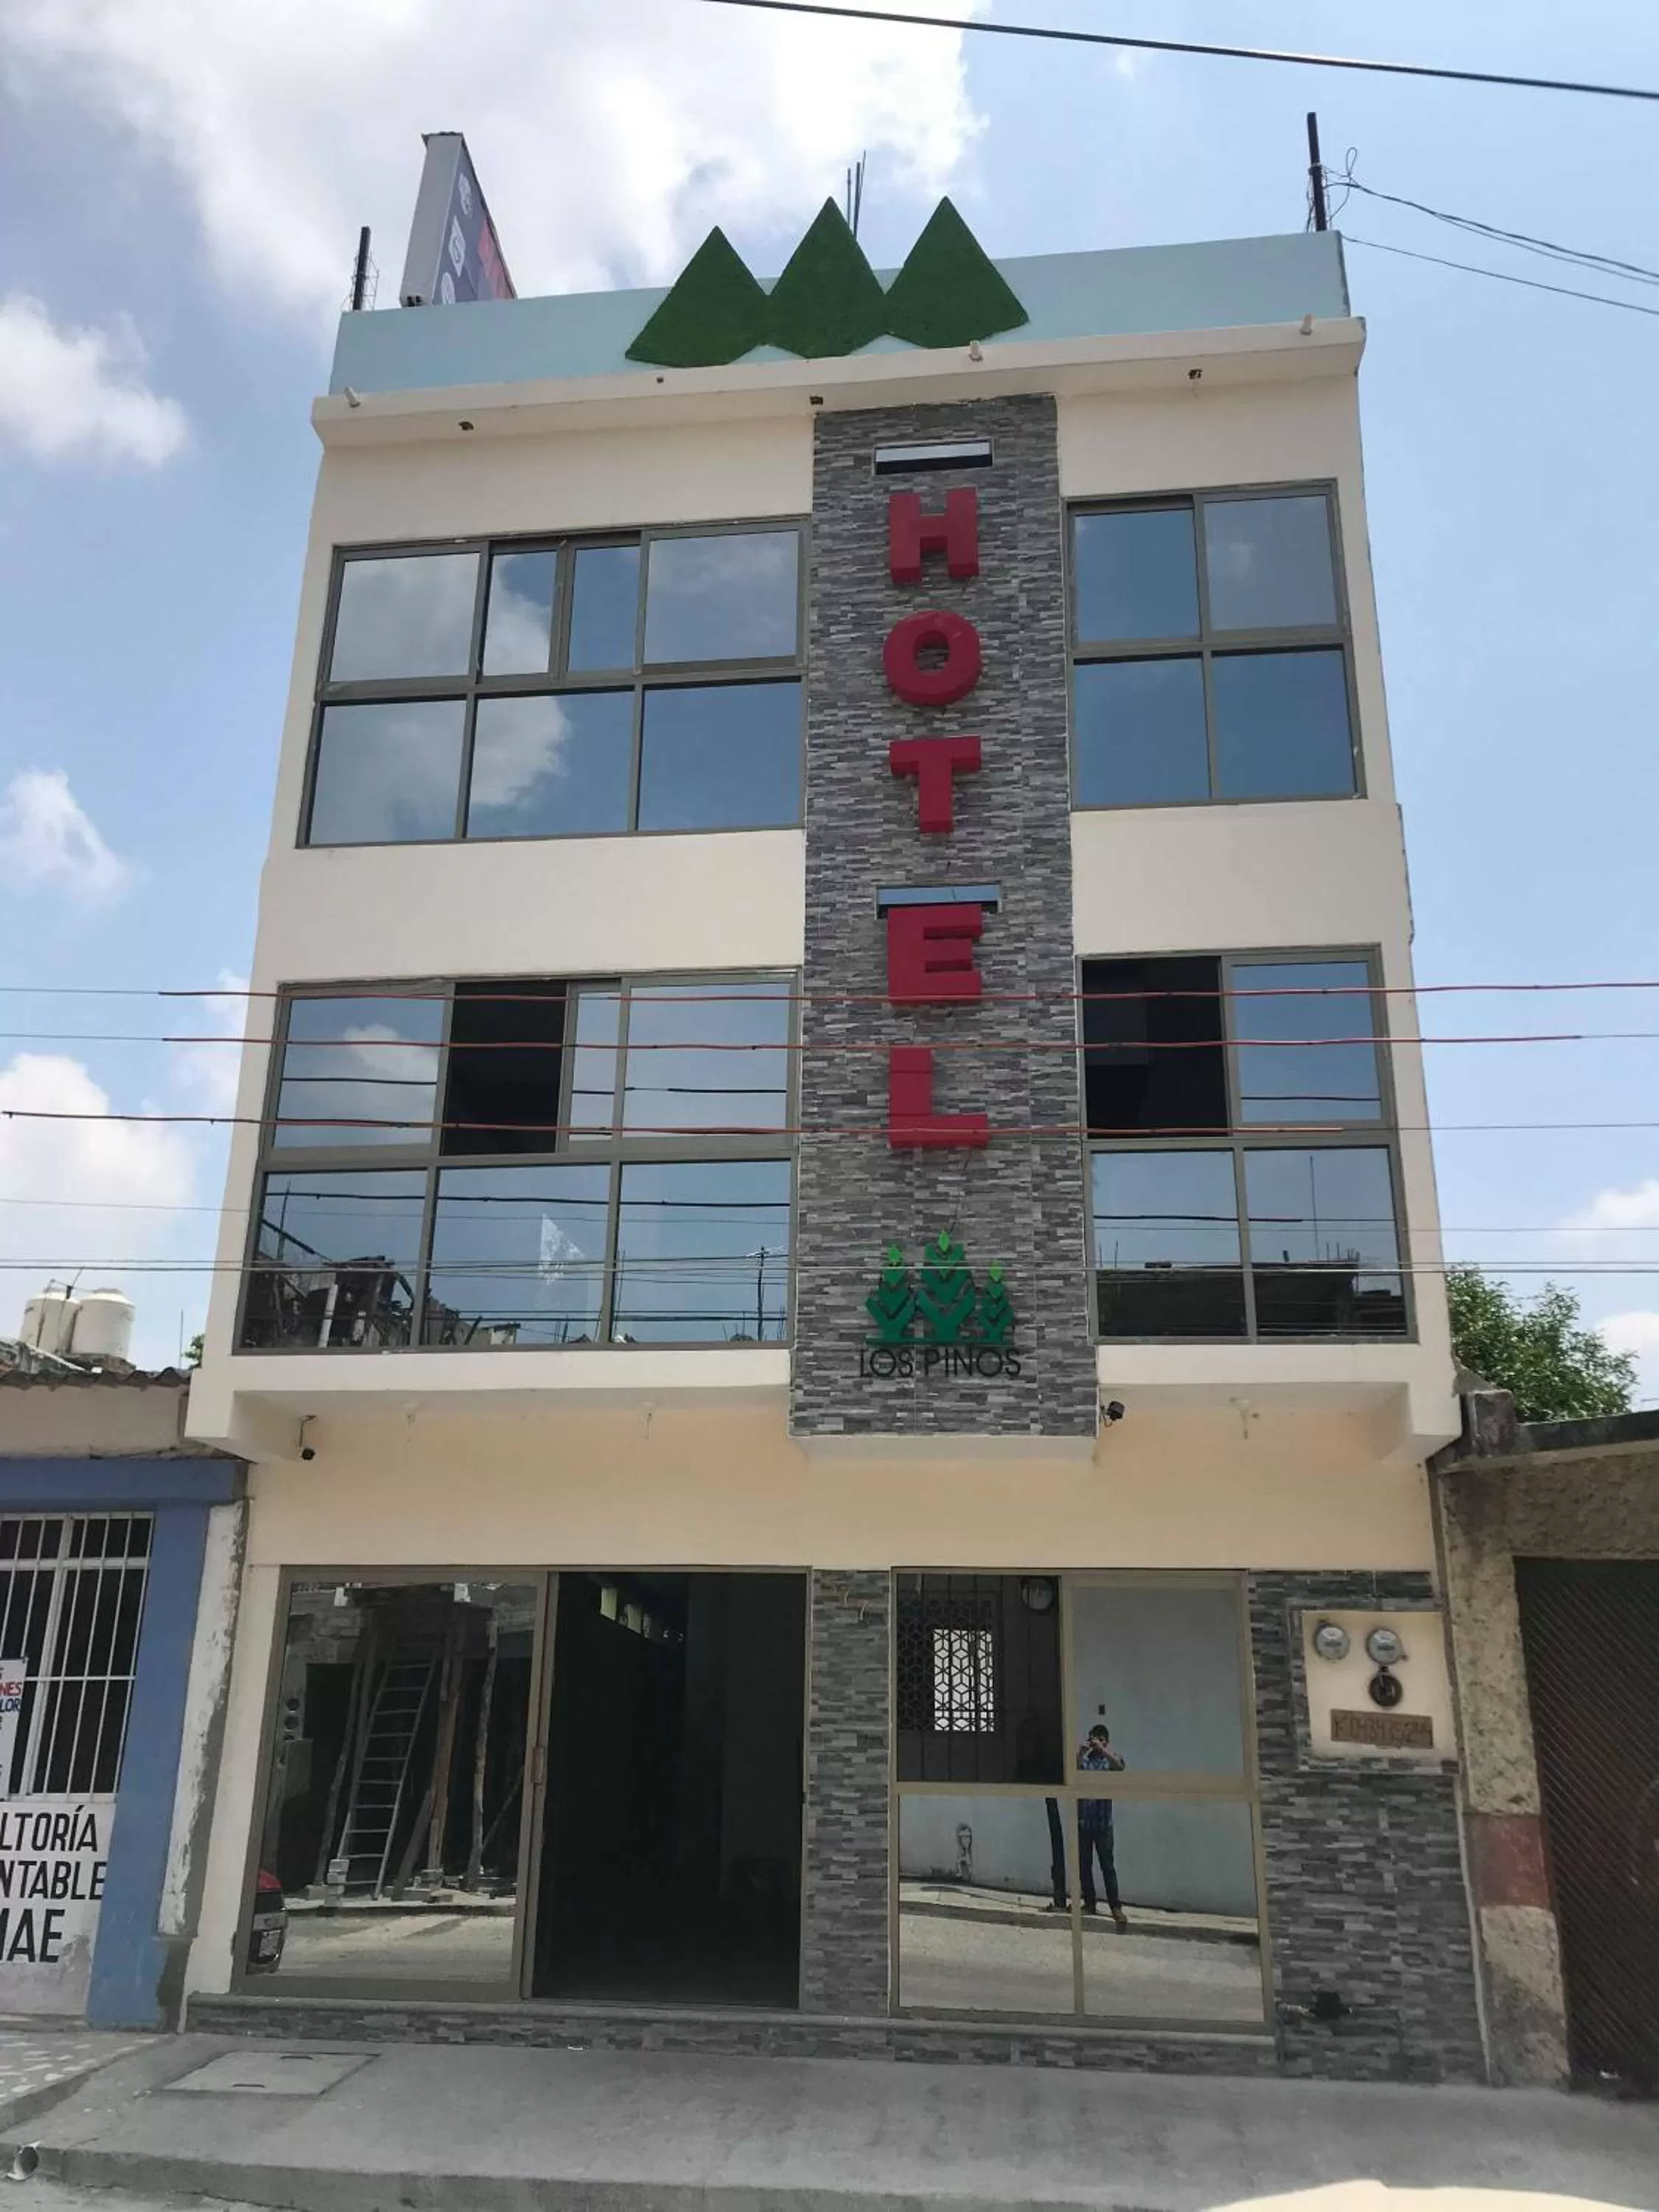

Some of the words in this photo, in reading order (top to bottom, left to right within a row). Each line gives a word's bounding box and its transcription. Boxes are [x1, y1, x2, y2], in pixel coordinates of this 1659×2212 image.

[883, 487, 989, 1149] HOTEL
[860, 1348, 914, 1377] LOS
[923, 1348, 1021, 1377] PINOS
[0, 1805, 97, 1852] LTORÍA
[0, 1860, 107, 1900] NTABLE
